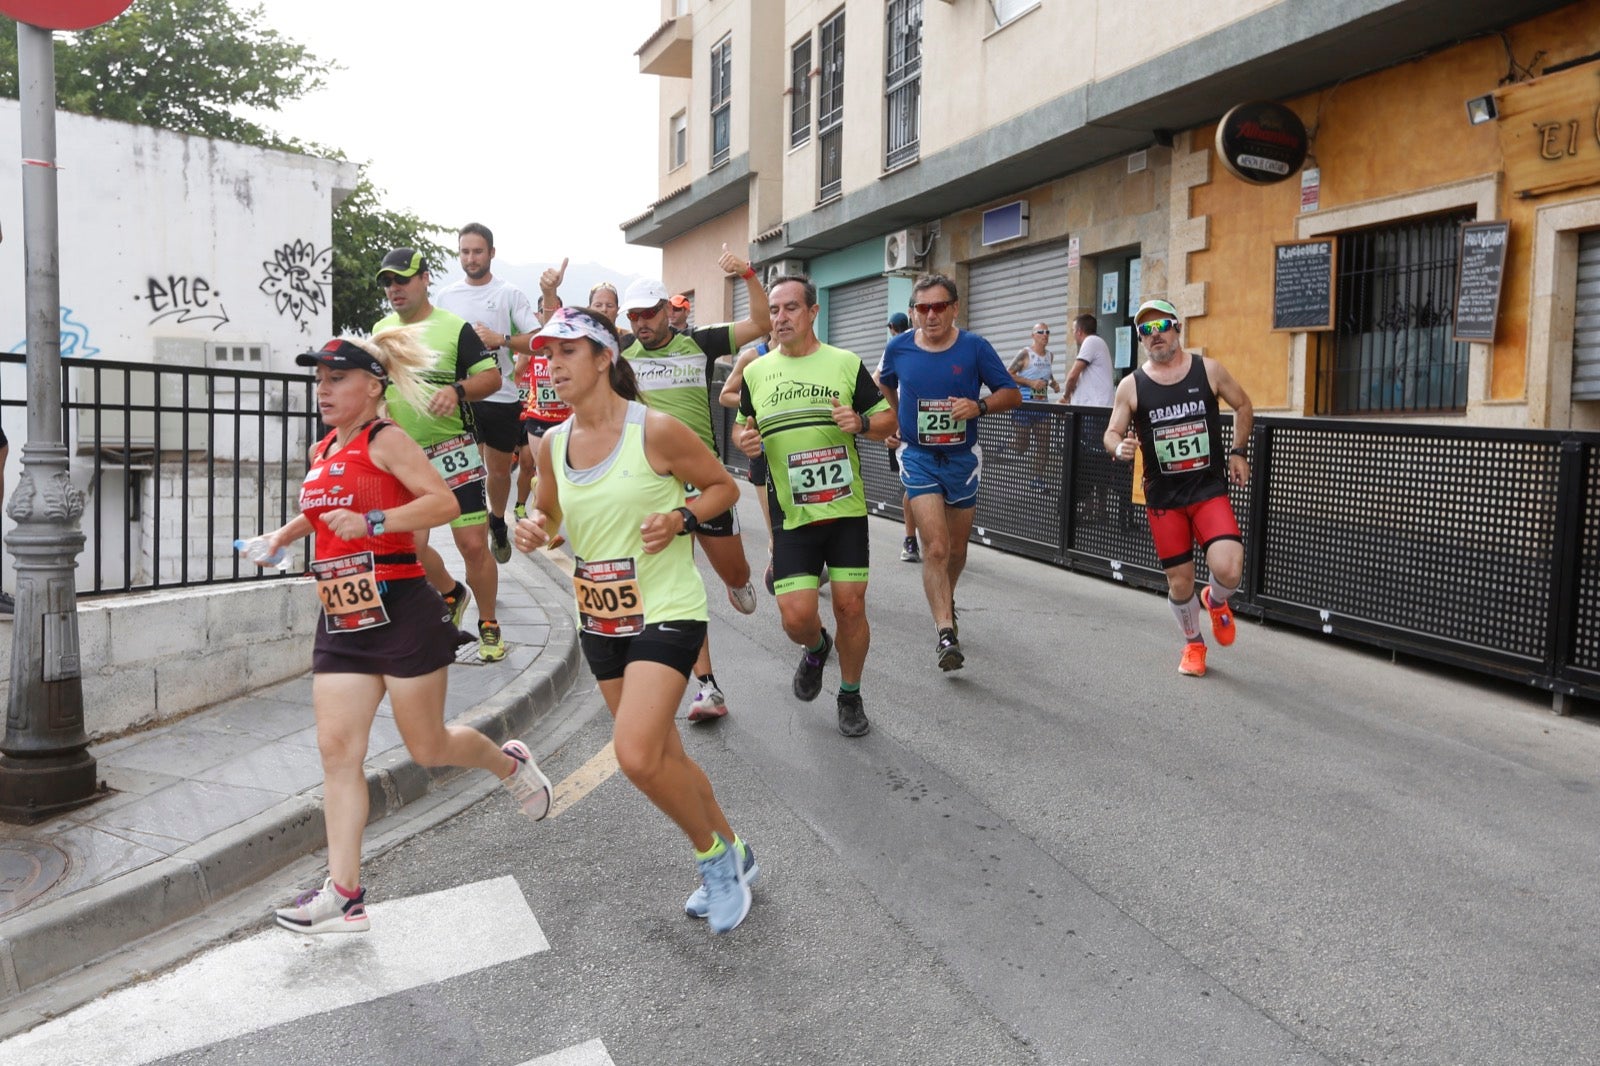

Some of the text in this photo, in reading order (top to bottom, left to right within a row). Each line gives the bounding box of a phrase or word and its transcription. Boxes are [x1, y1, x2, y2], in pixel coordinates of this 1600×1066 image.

[1538, 120, 1580, 160] El
[1149, 400, 1206, 420] GRANADA
[1165, 436, 1201, 458] 151
[442, 450, 469, 473] 83
[800, 463, 844, 488] 312
[323, 579, 374, 608] 2138
[580, 585, 637, 612] 2005
